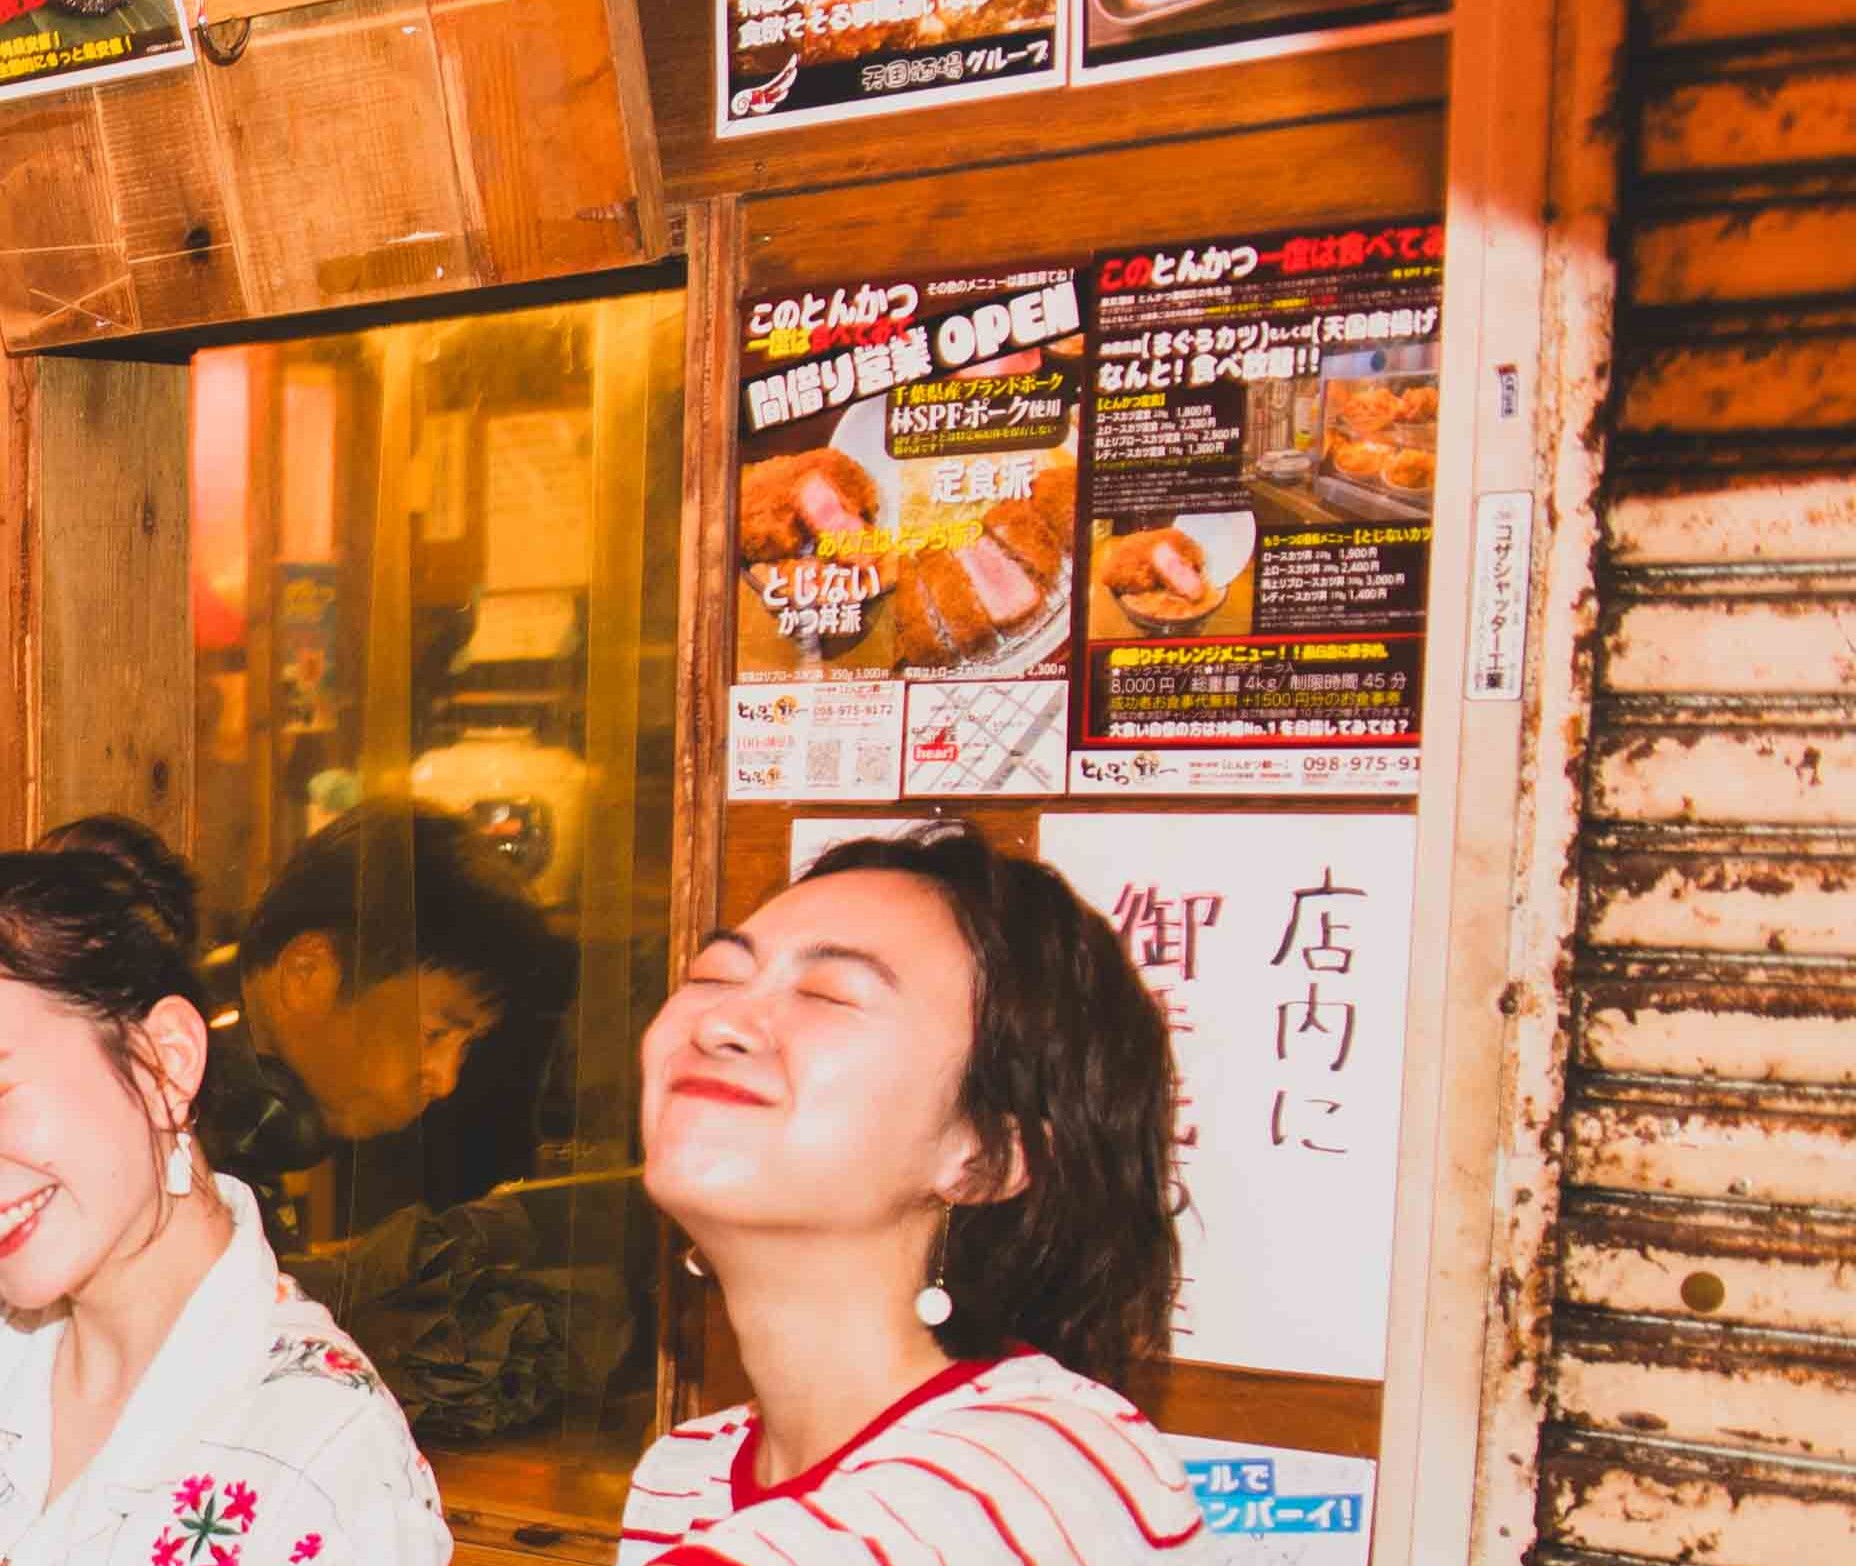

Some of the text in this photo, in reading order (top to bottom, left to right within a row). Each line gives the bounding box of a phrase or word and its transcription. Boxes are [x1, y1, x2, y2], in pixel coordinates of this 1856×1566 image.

[749, 283, 919, 335] このとんかつ
[748, 280, 1080, 431] 間借り営業 OPEN
[933, 456, 1035, 502] 定食派
[763, 563, 880, 607] とじない
[778, 603, 863, 635] かつ丼派
[1269, 865, 1368, 1154] 店内に
